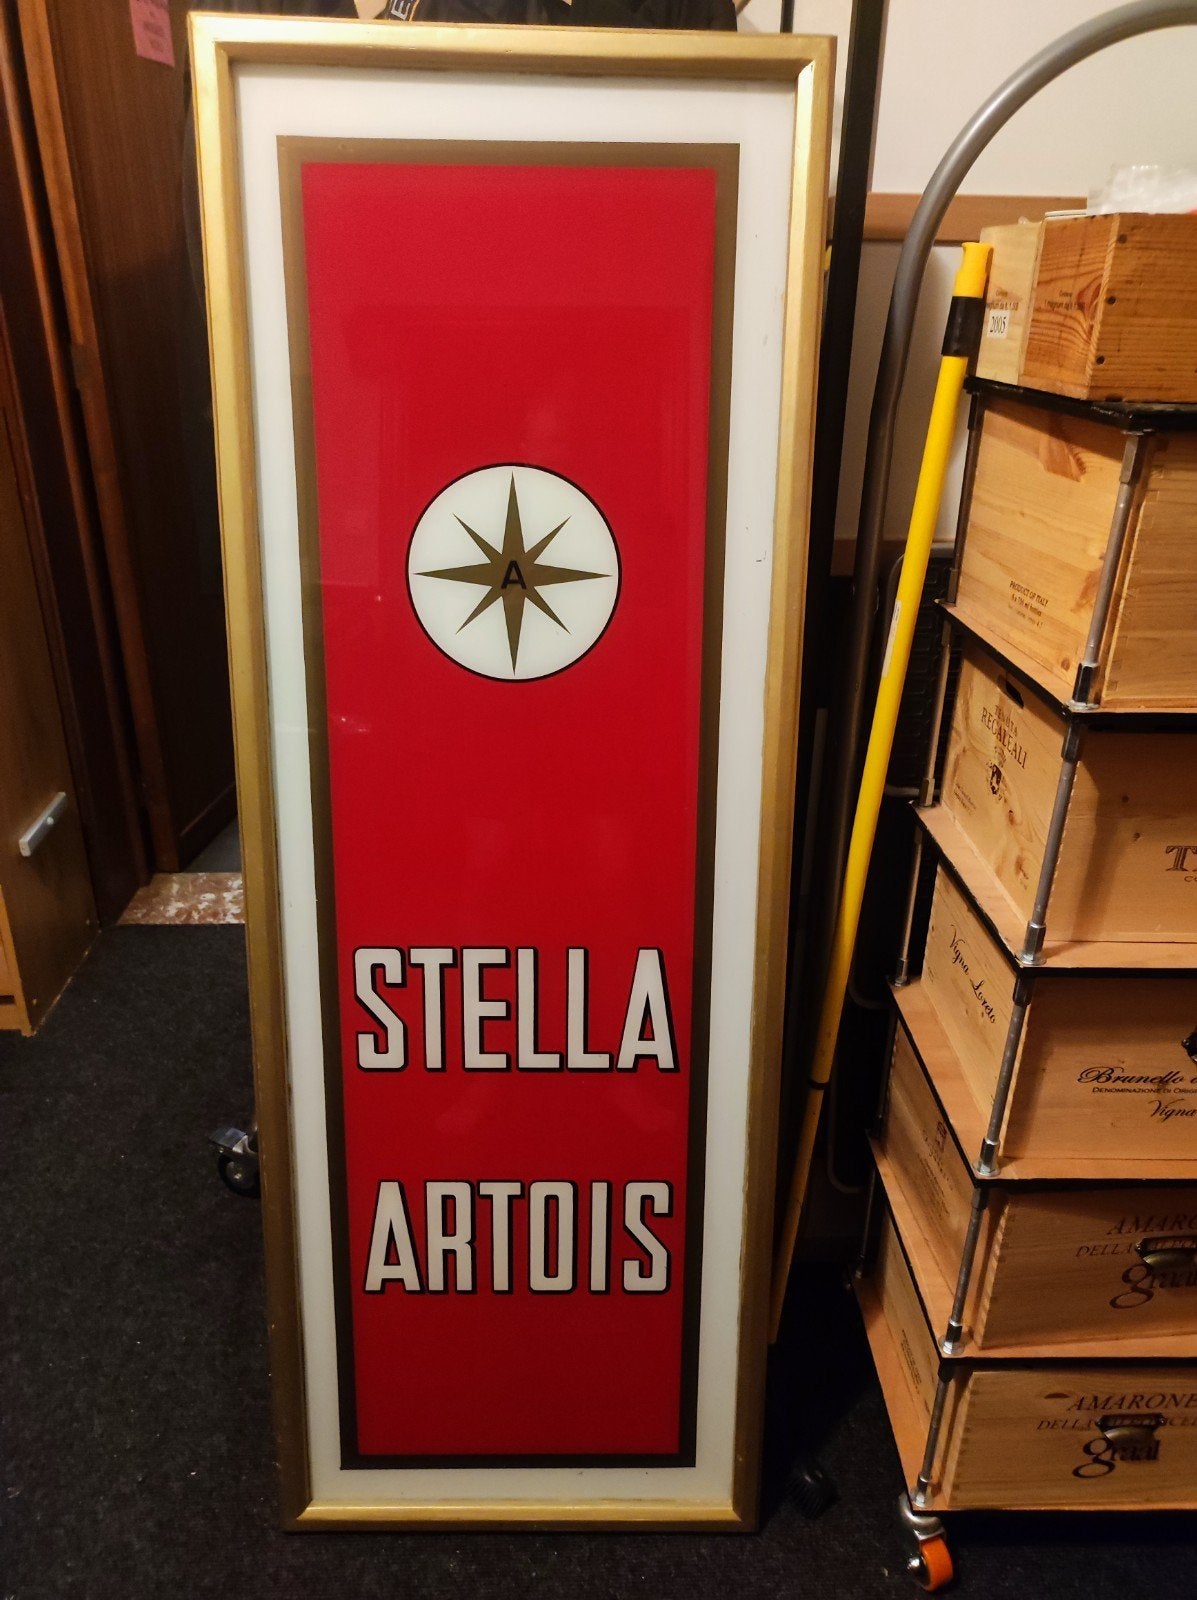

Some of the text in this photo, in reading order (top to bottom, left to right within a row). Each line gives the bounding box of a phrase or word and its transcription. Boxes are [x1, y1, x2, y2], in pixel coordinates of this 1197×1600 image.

[990, 316, 1006, 333] 2005
[501, 560, 527, 589] A
[1010, 581, 1030, 597] PRODUCT
[1036, 595, 1048, 606] ITALY
[950, 924, 995, 1023] Vigna Loreto
[353, 947, 679, 1073] STELLA
[1078, 1066, 1184, 1084] Brunello
[1148, 1098, 1197, 1123] Vigna
[363, 1180, 674, 1293] ARTOIS
[1076, 1243, 1133, 1257] DELLA
[1067, 1392, 1197, 1411] AMARONE
